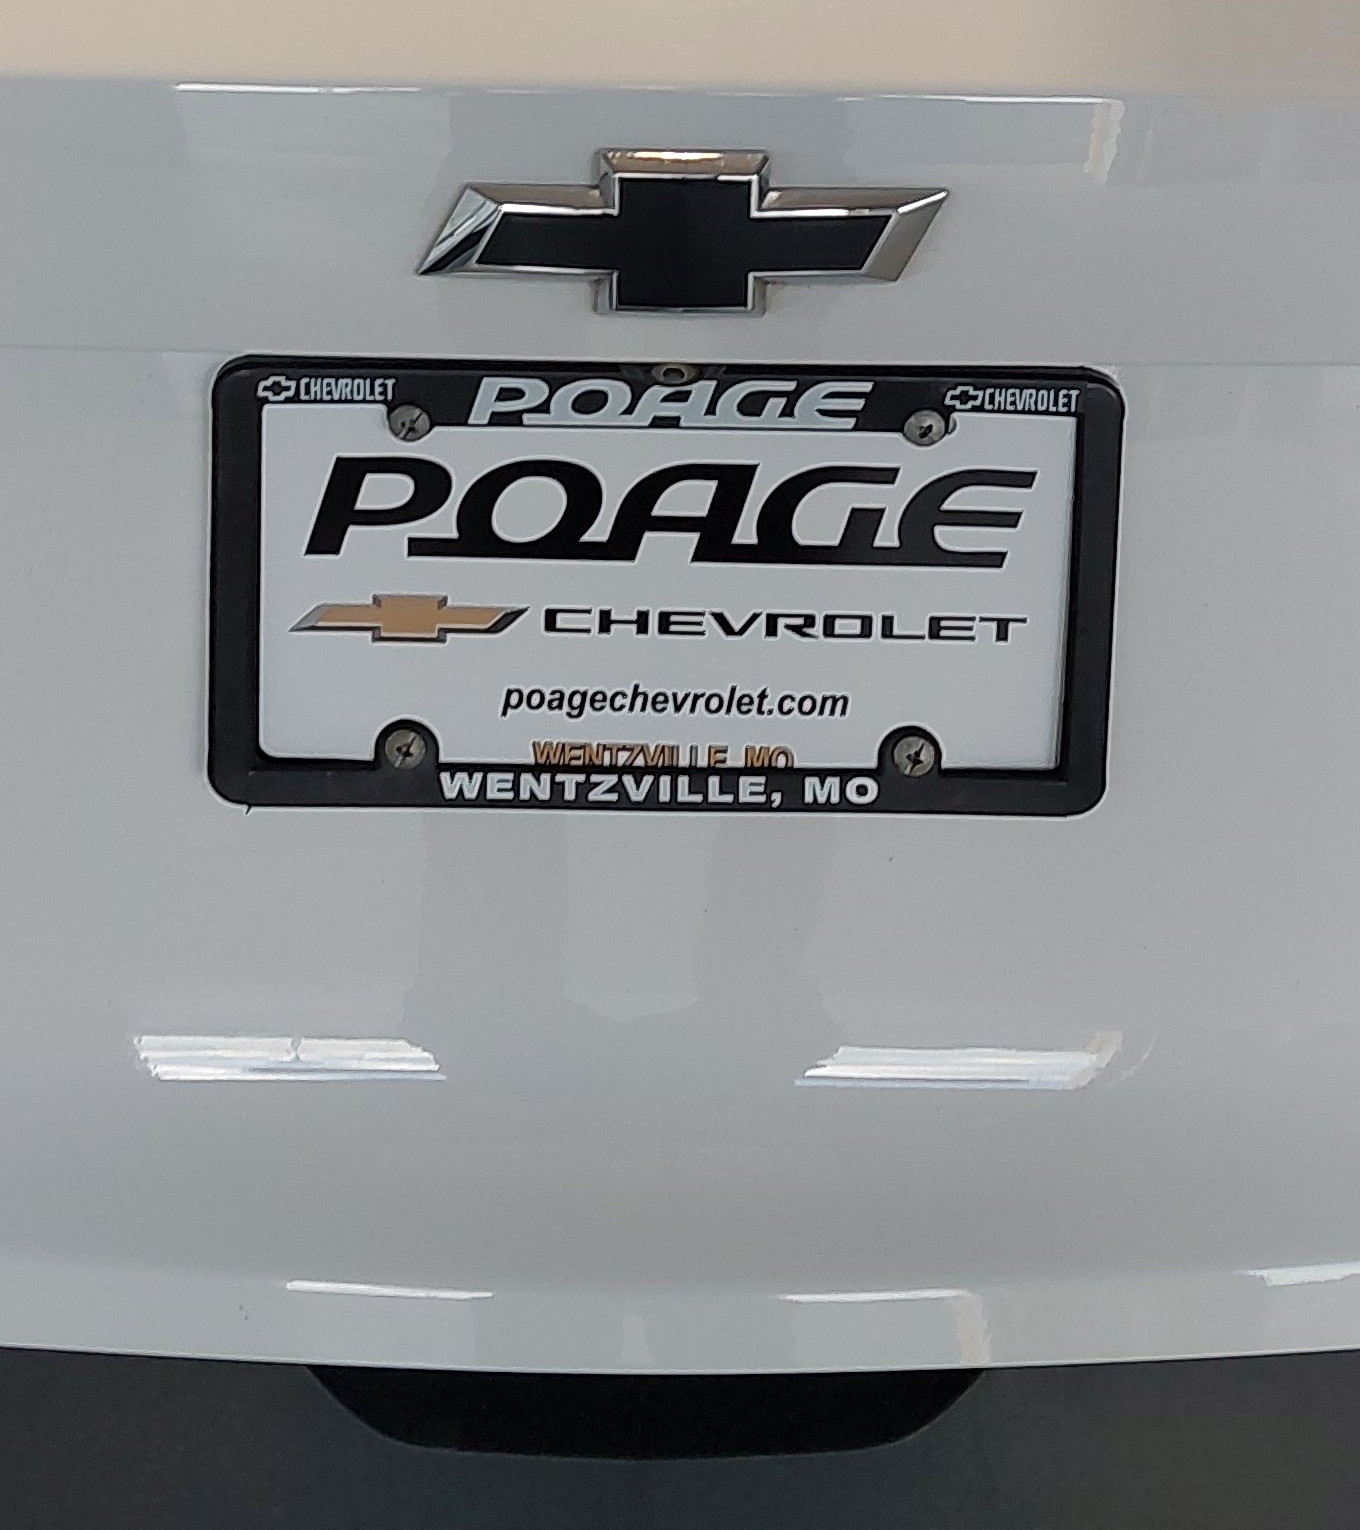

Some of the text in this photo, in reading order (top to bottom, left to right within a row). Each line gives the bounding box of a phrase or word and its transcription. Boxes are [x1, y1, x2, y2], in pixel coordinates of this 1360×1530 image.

[300, 377, 396, 401] CHEVROLET
[467, 377, 875, 430] POAGE
[983, 387, 1080, 412] CHEVROLET
[302, 456, 1039, 569] POAGE
[543, 606, 1028, 644] CHEVROLET
[501, 683, 849, 718] poagechevrolet.com
[439, 772, 879, 808] WENTZVILLE, MO
